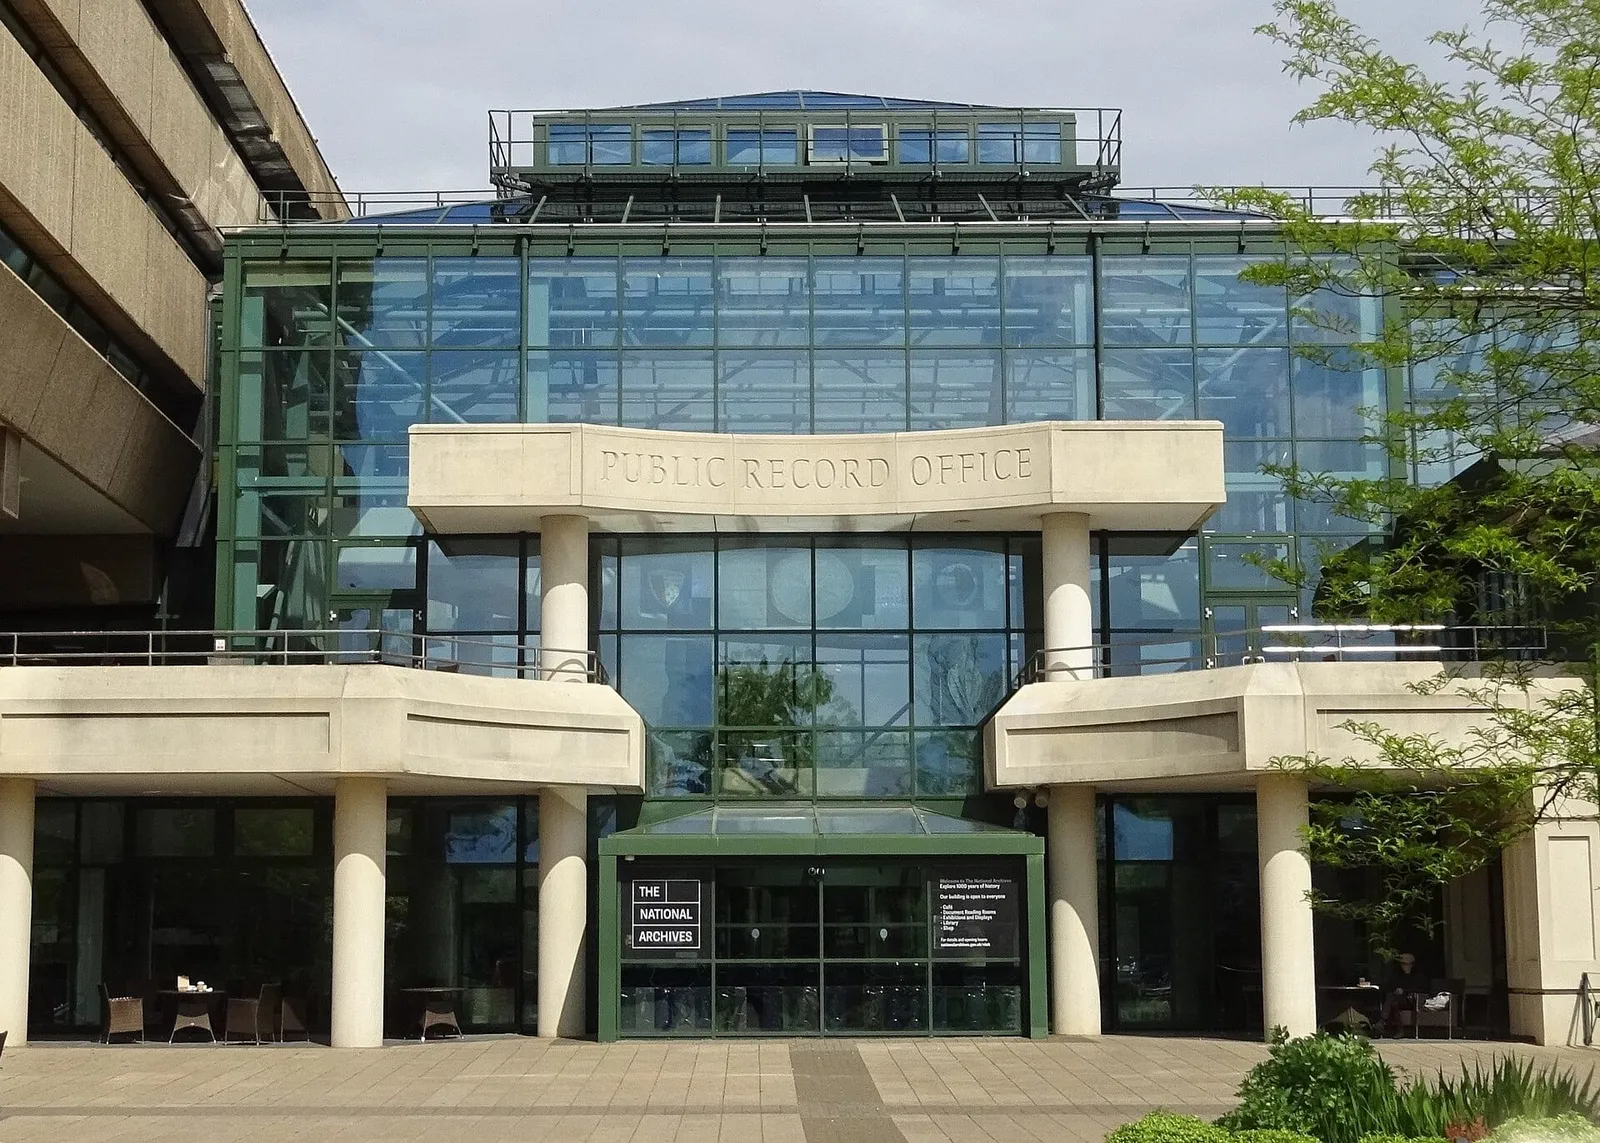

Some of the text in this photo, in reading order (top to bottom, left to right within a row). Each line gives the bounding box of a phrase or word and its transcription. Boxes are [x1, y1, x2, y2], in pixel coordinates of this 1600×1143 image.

[600, 448, 1032, 490] PUBLIC RECORD OFFICE
[638, 886, 660, 897] THE
[640, 908, 693, 920] NATIONAL
[638, 931, 693, 942] ARCHIVES
